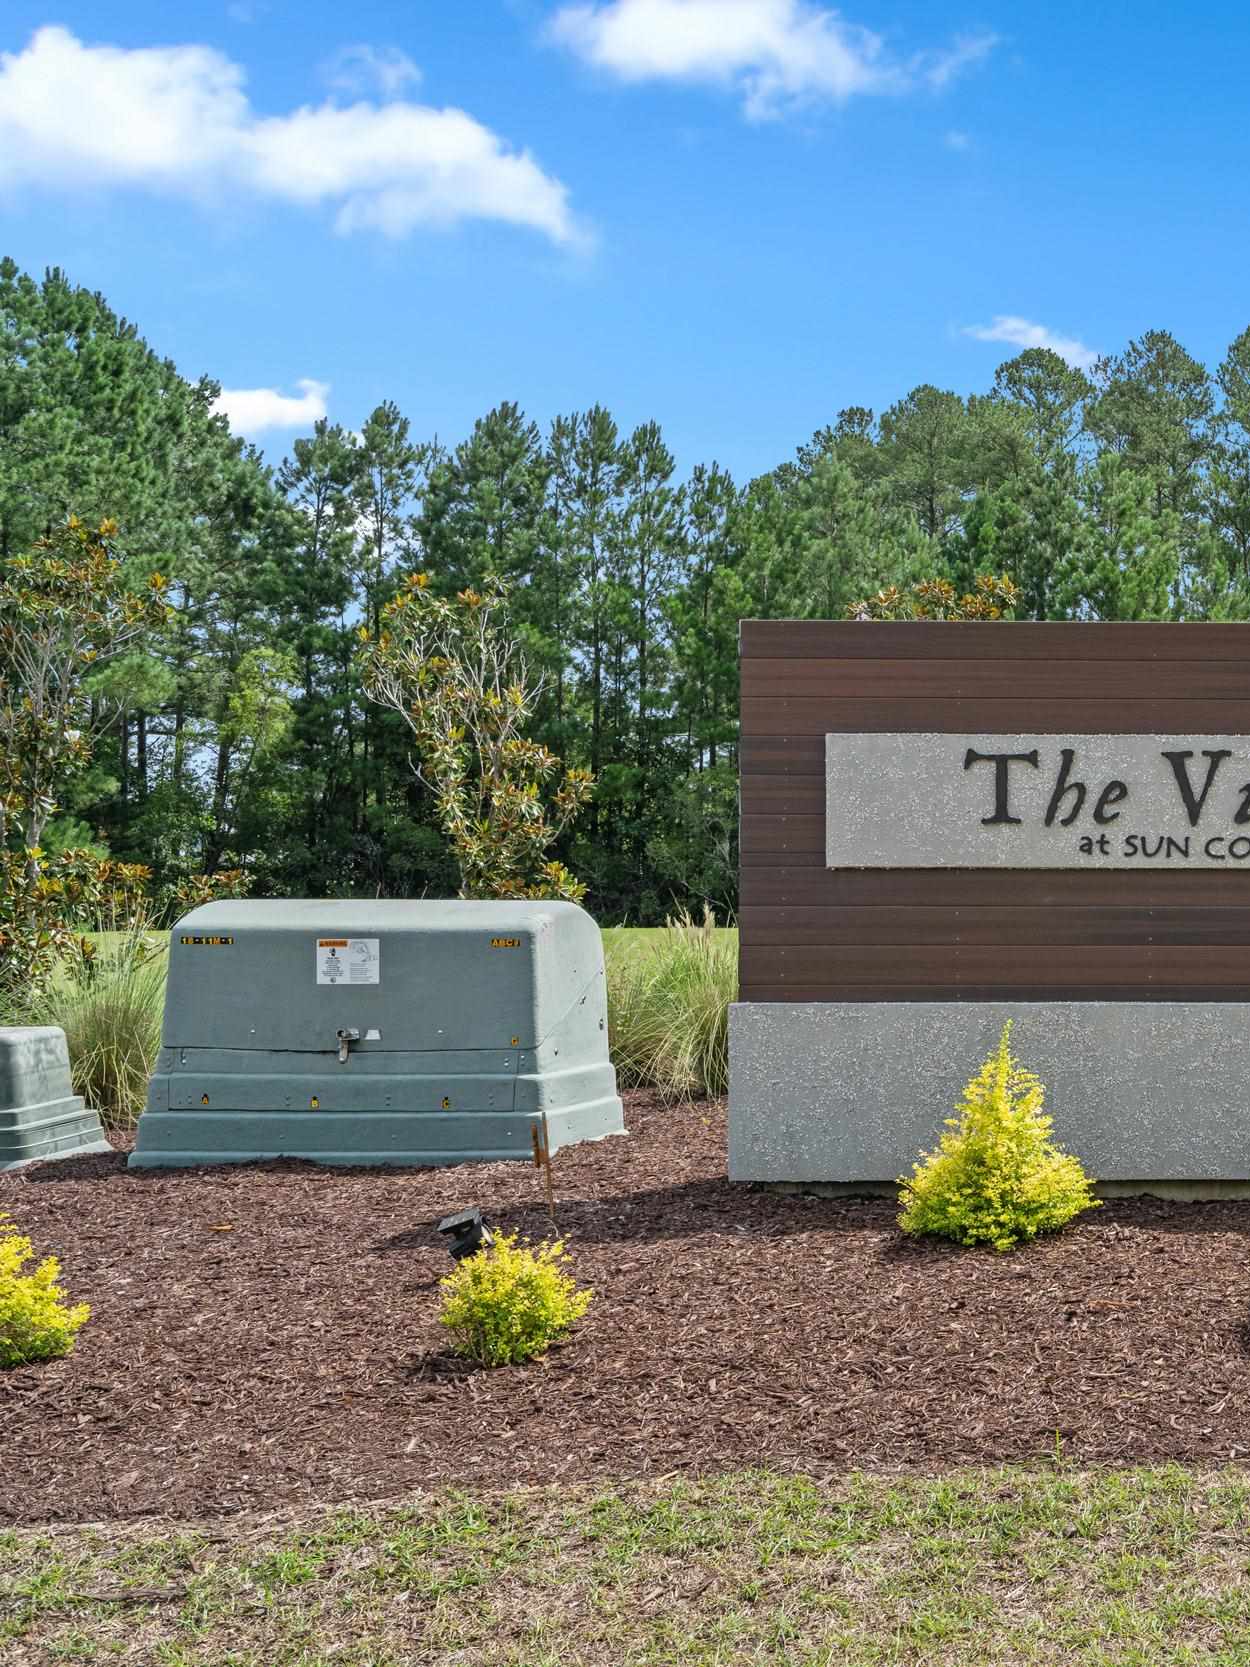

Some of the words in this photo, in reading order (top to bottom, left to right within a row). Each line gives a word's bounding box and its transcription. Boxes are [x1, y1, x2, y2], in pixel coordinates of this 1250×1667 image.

[964, 748, 1128, 827] The
[1079, 833, 1111, 856] at
[1124, 834, 1191, 859] SUN
